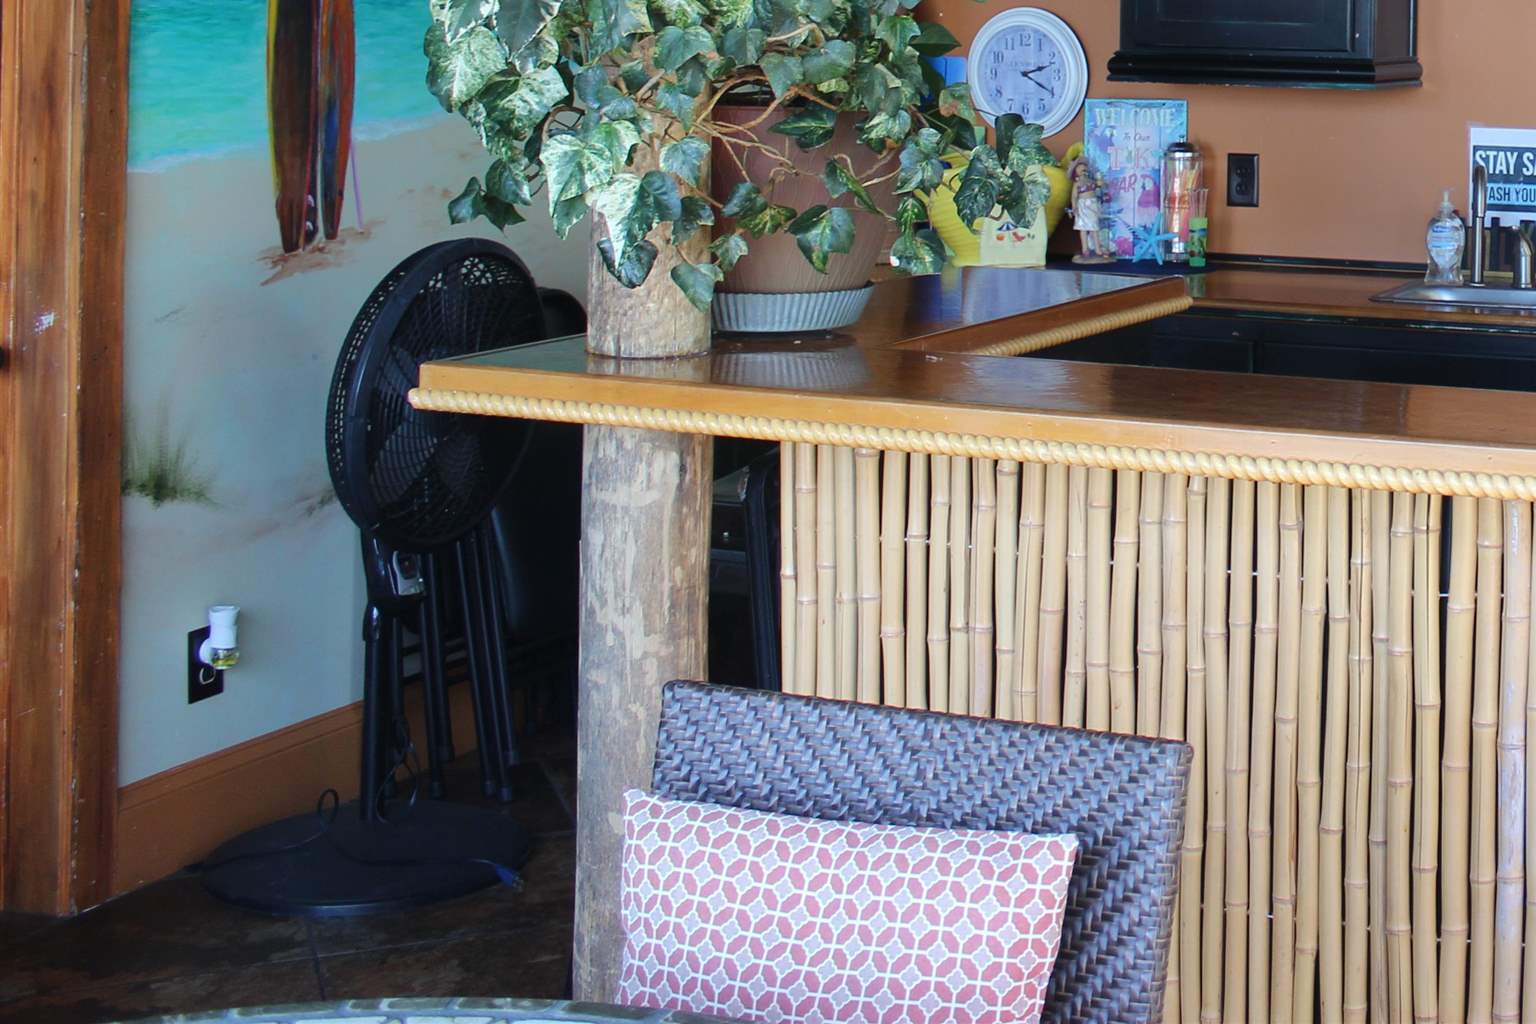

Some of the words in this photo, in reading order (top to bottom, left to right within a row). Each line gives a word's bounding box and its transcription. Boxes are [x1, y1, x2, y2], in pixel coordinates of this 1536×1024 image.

[1004, 38, 1015, 51] 11
[1020, 33, 1032, 47] 12
[1038, 38, 1043, 52] 1
[992, 51, 1004, 64] 10
[1049, 52, 1056, 65] 2
[990, 68, 998, 80] 9
[1053, 69, 1062, 81] 3
[995, 85, 1003, 98] 8
[1007, 98, 1015, 112] 7
[1022, 102, 1030, 115] 6
[1038, 98, 1046, 112] 5
[1094, 108, 1176, 126] WELCOME
[1475, 150, 1518, 175] STAY
[1488, 186, 1512, 202] ASH
